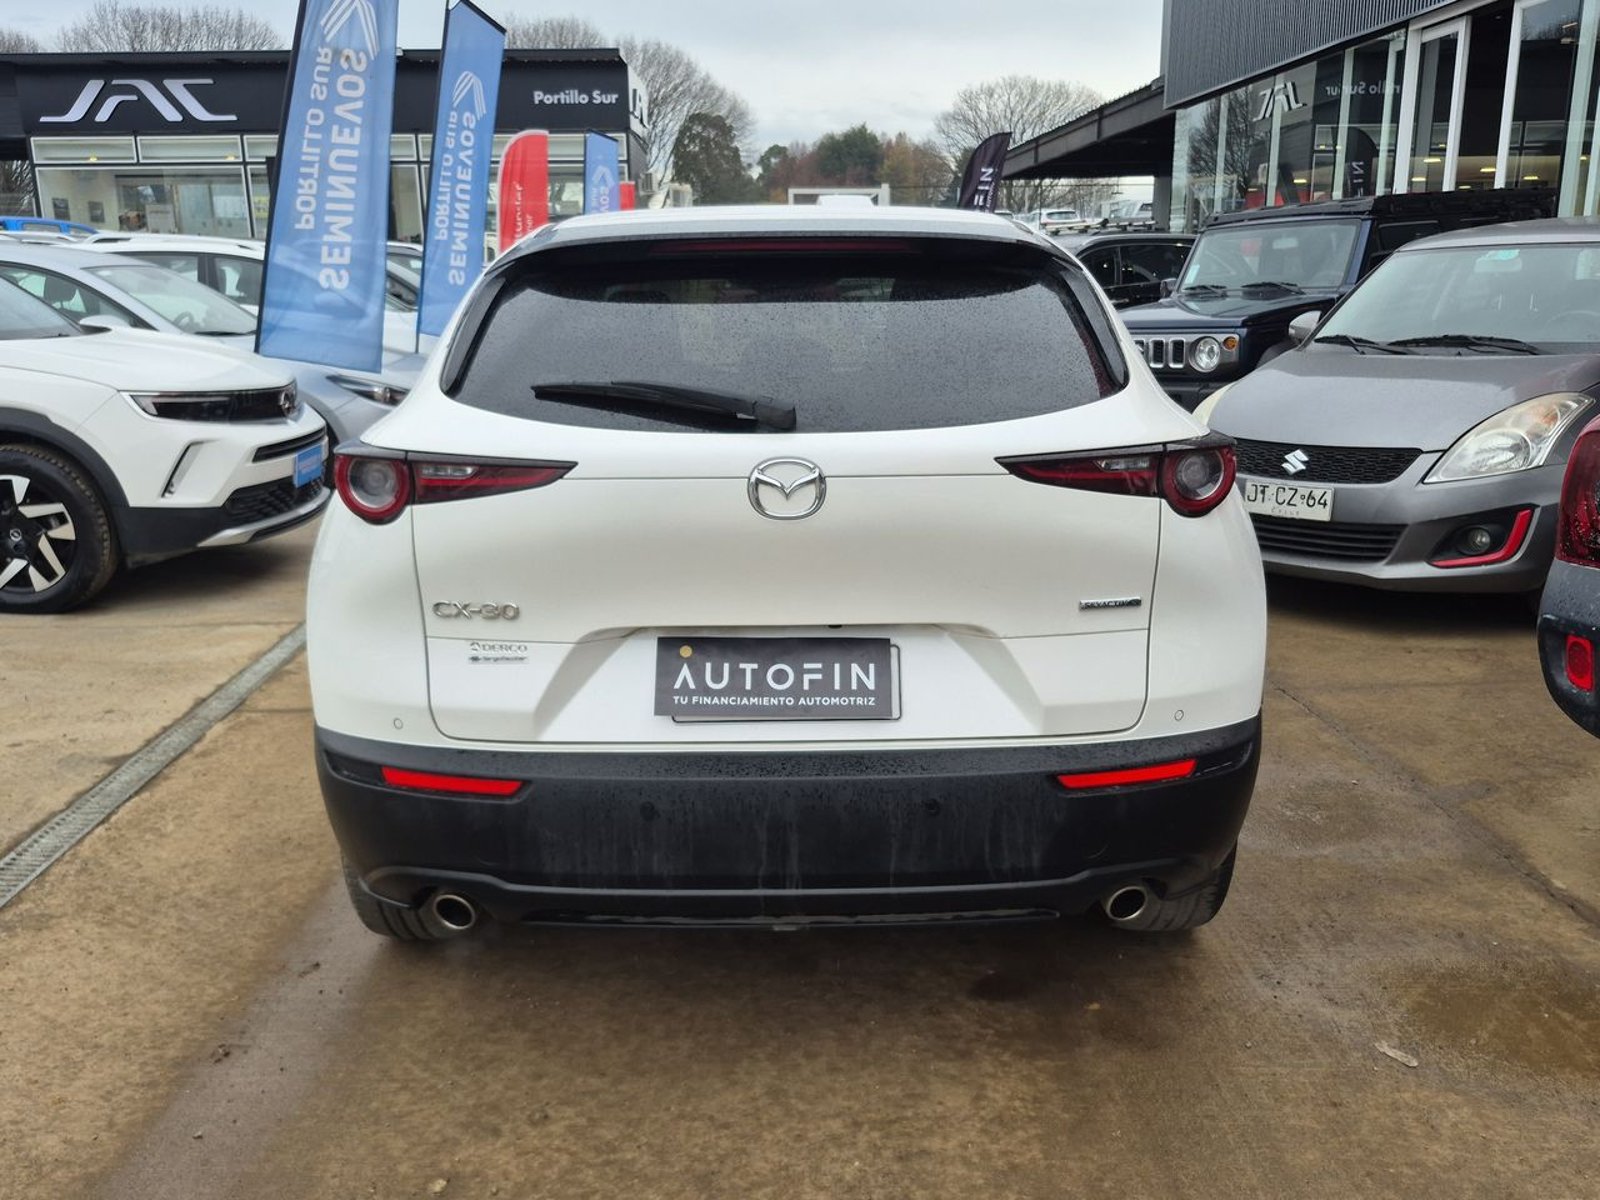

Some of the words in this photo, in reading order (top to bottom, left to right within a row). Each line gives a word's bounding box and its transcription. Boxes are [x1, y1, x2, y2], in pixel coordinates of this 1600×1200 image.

[39, 79, 238, 122] JAC
[533, 89, 589, 104] Portillo
[592, 90, 618, 104] Sur
[432, 600, 520, 620] CX-30
[482, 643, 528, 652] DERCO
[673, 662, 875, 691] AUTOFIN
[673, 695, 688, 705] TU
[692, 695, 794, 706] FINANCIAMIENTO
[798, 696, 876, 706] AUTOMOTRIZ
